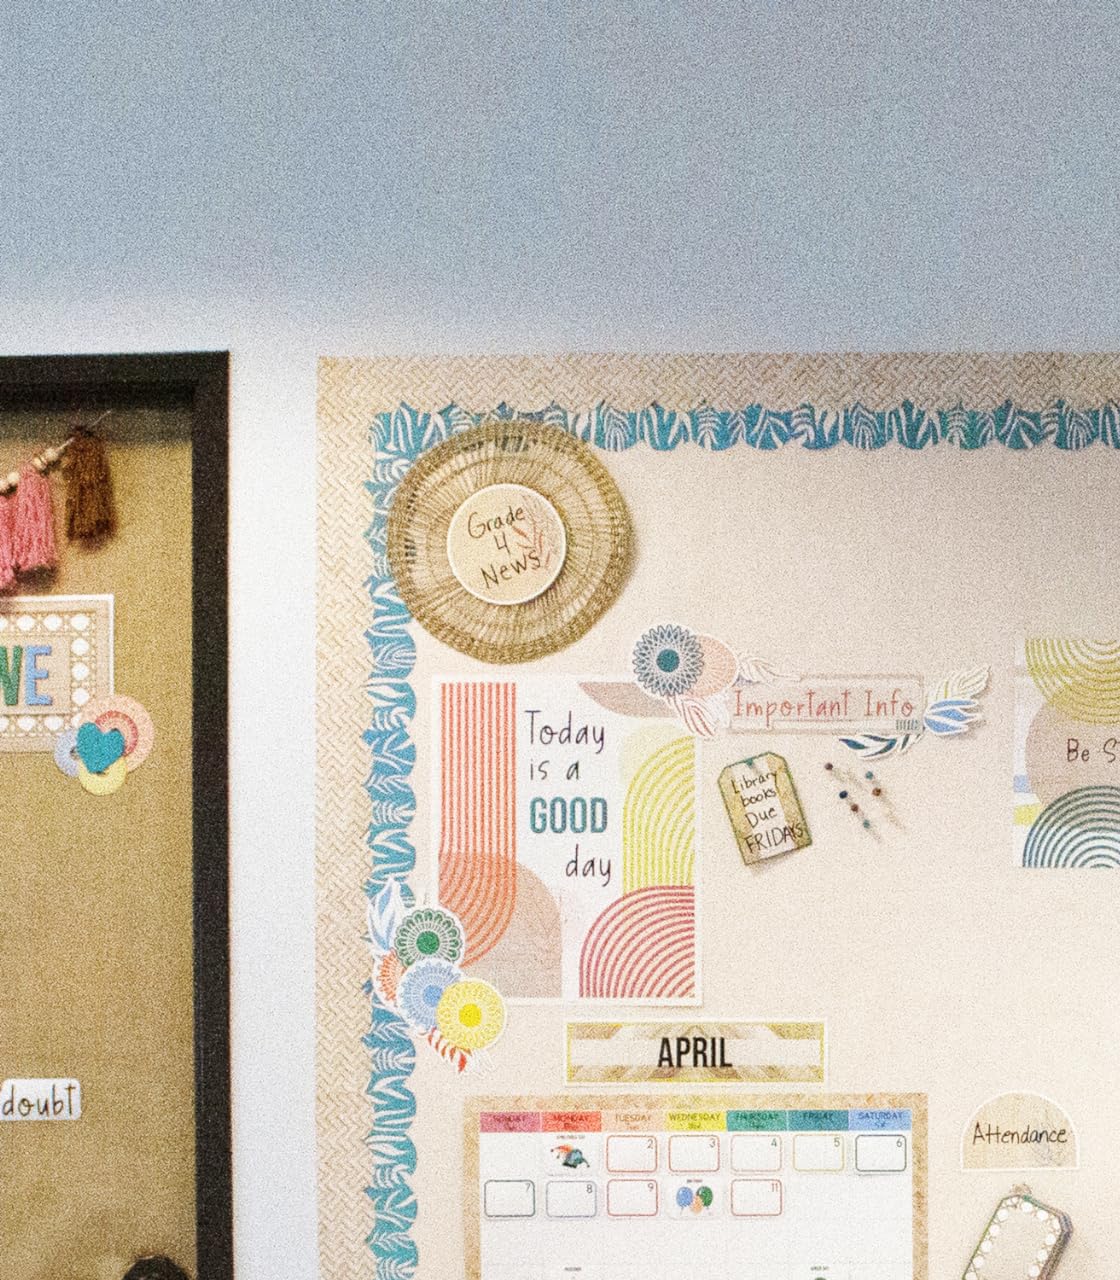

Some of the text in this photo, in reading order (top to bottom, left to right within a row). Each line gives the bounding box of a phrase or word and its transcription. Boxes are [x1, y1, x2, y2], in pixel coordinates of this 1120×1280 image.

[468, 506, 525, 539] Grade
[493, 531, 511, 555] 4
[480, 549, 541, 589] News
[733, 688, 914, 728] Important Info
[524, 710, 605, 754] Today
[1067, 738, 1090, 762] Be
[529, 758, 579, 780] is a
[731, 771, 779, 794] Library
[740, 788, 777, 807] books
[529, 796, 608, 834] GOOD
[745, 807, 778, 829] Due
[744, 822, 804, 853] FRIDAYS
[565, 843, 612, 887] day
[658, 1036, 733, 1068] APRIL
[2, 1084, 77, 1117] doubt
[647, 1138, 654, 1149] 2
[833, 1137, 841, 1148] 5
[972, 1121, 1068, 1145] Attendance
[525, 1183, 531, 1193] 7
[586, 1184, 593, 1194] 8
[647, 1183, 654, 1193] 9
